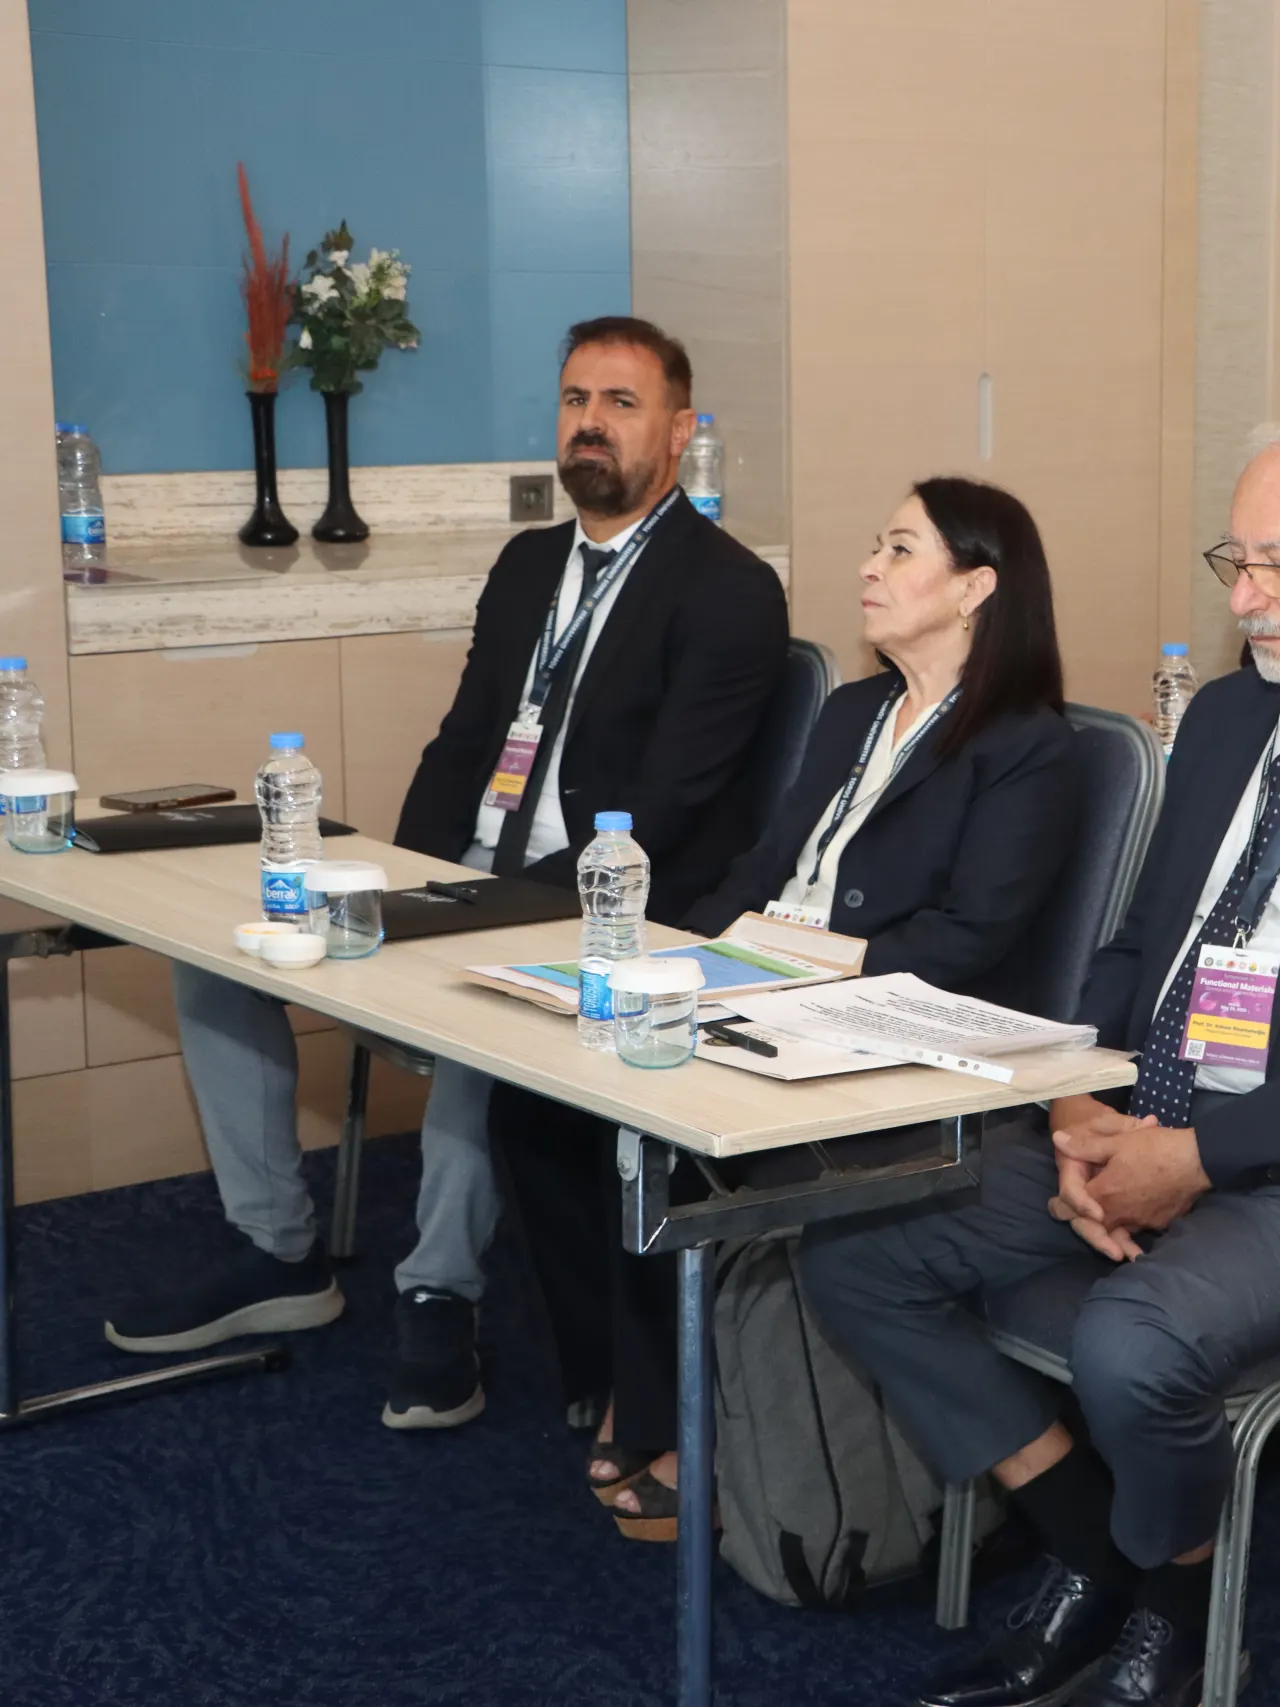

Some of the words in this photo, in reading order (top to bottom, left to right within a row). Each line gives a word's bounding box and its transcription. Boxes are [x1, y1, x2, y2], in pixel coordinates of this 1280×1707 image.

[266, 887, 299, 899] berrak
[1200, 977, 1239, 989] Functional
[1240, 982, 1275, 994] Materials
